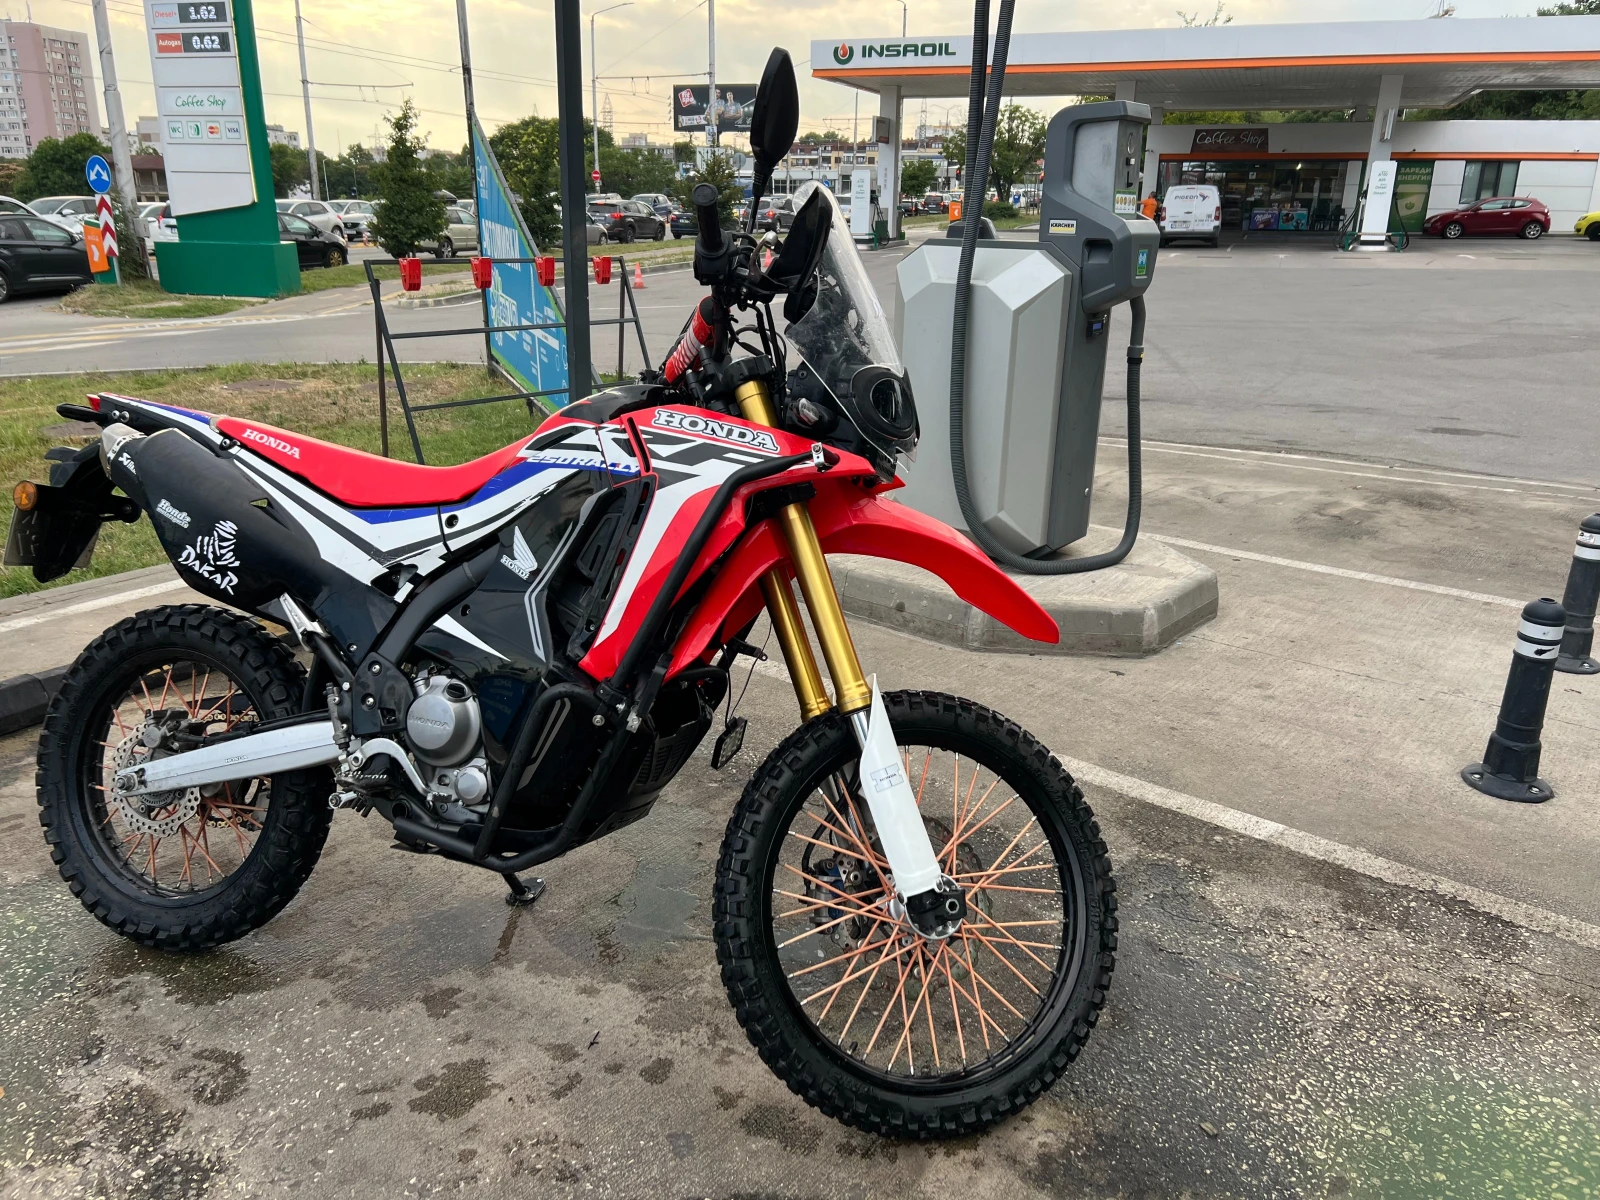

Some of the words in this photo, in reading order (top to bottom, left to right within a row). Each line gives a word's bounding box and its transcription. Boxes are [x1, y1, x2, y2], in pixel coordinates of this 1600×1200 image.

[188, 6, 217, 20] 1.62
[158, 39, 182, 48] Autogas
[191, 35, 221, 50] 0.62
[861, 42, 957, 58] INSAOIL
[175, 95, 205, 108] Coffee
[206, 94, 227, 111] Shop
[170, 126, 182, 134] WC
[226, 126, 239, 134] VISA
[1196, 131, 1236, 145] Coffee
[1239, 131, 1265, 149] Shop
[653, 408, 780, 452] HONDA
[241, 427, 301, 460] HONDA
[157, 498, 192, 523] Honda
[177, 544, 239, 596] DAKAR
[408, 714, 451, 730] HONDA
[224, 754, 249, 763] HONDA
